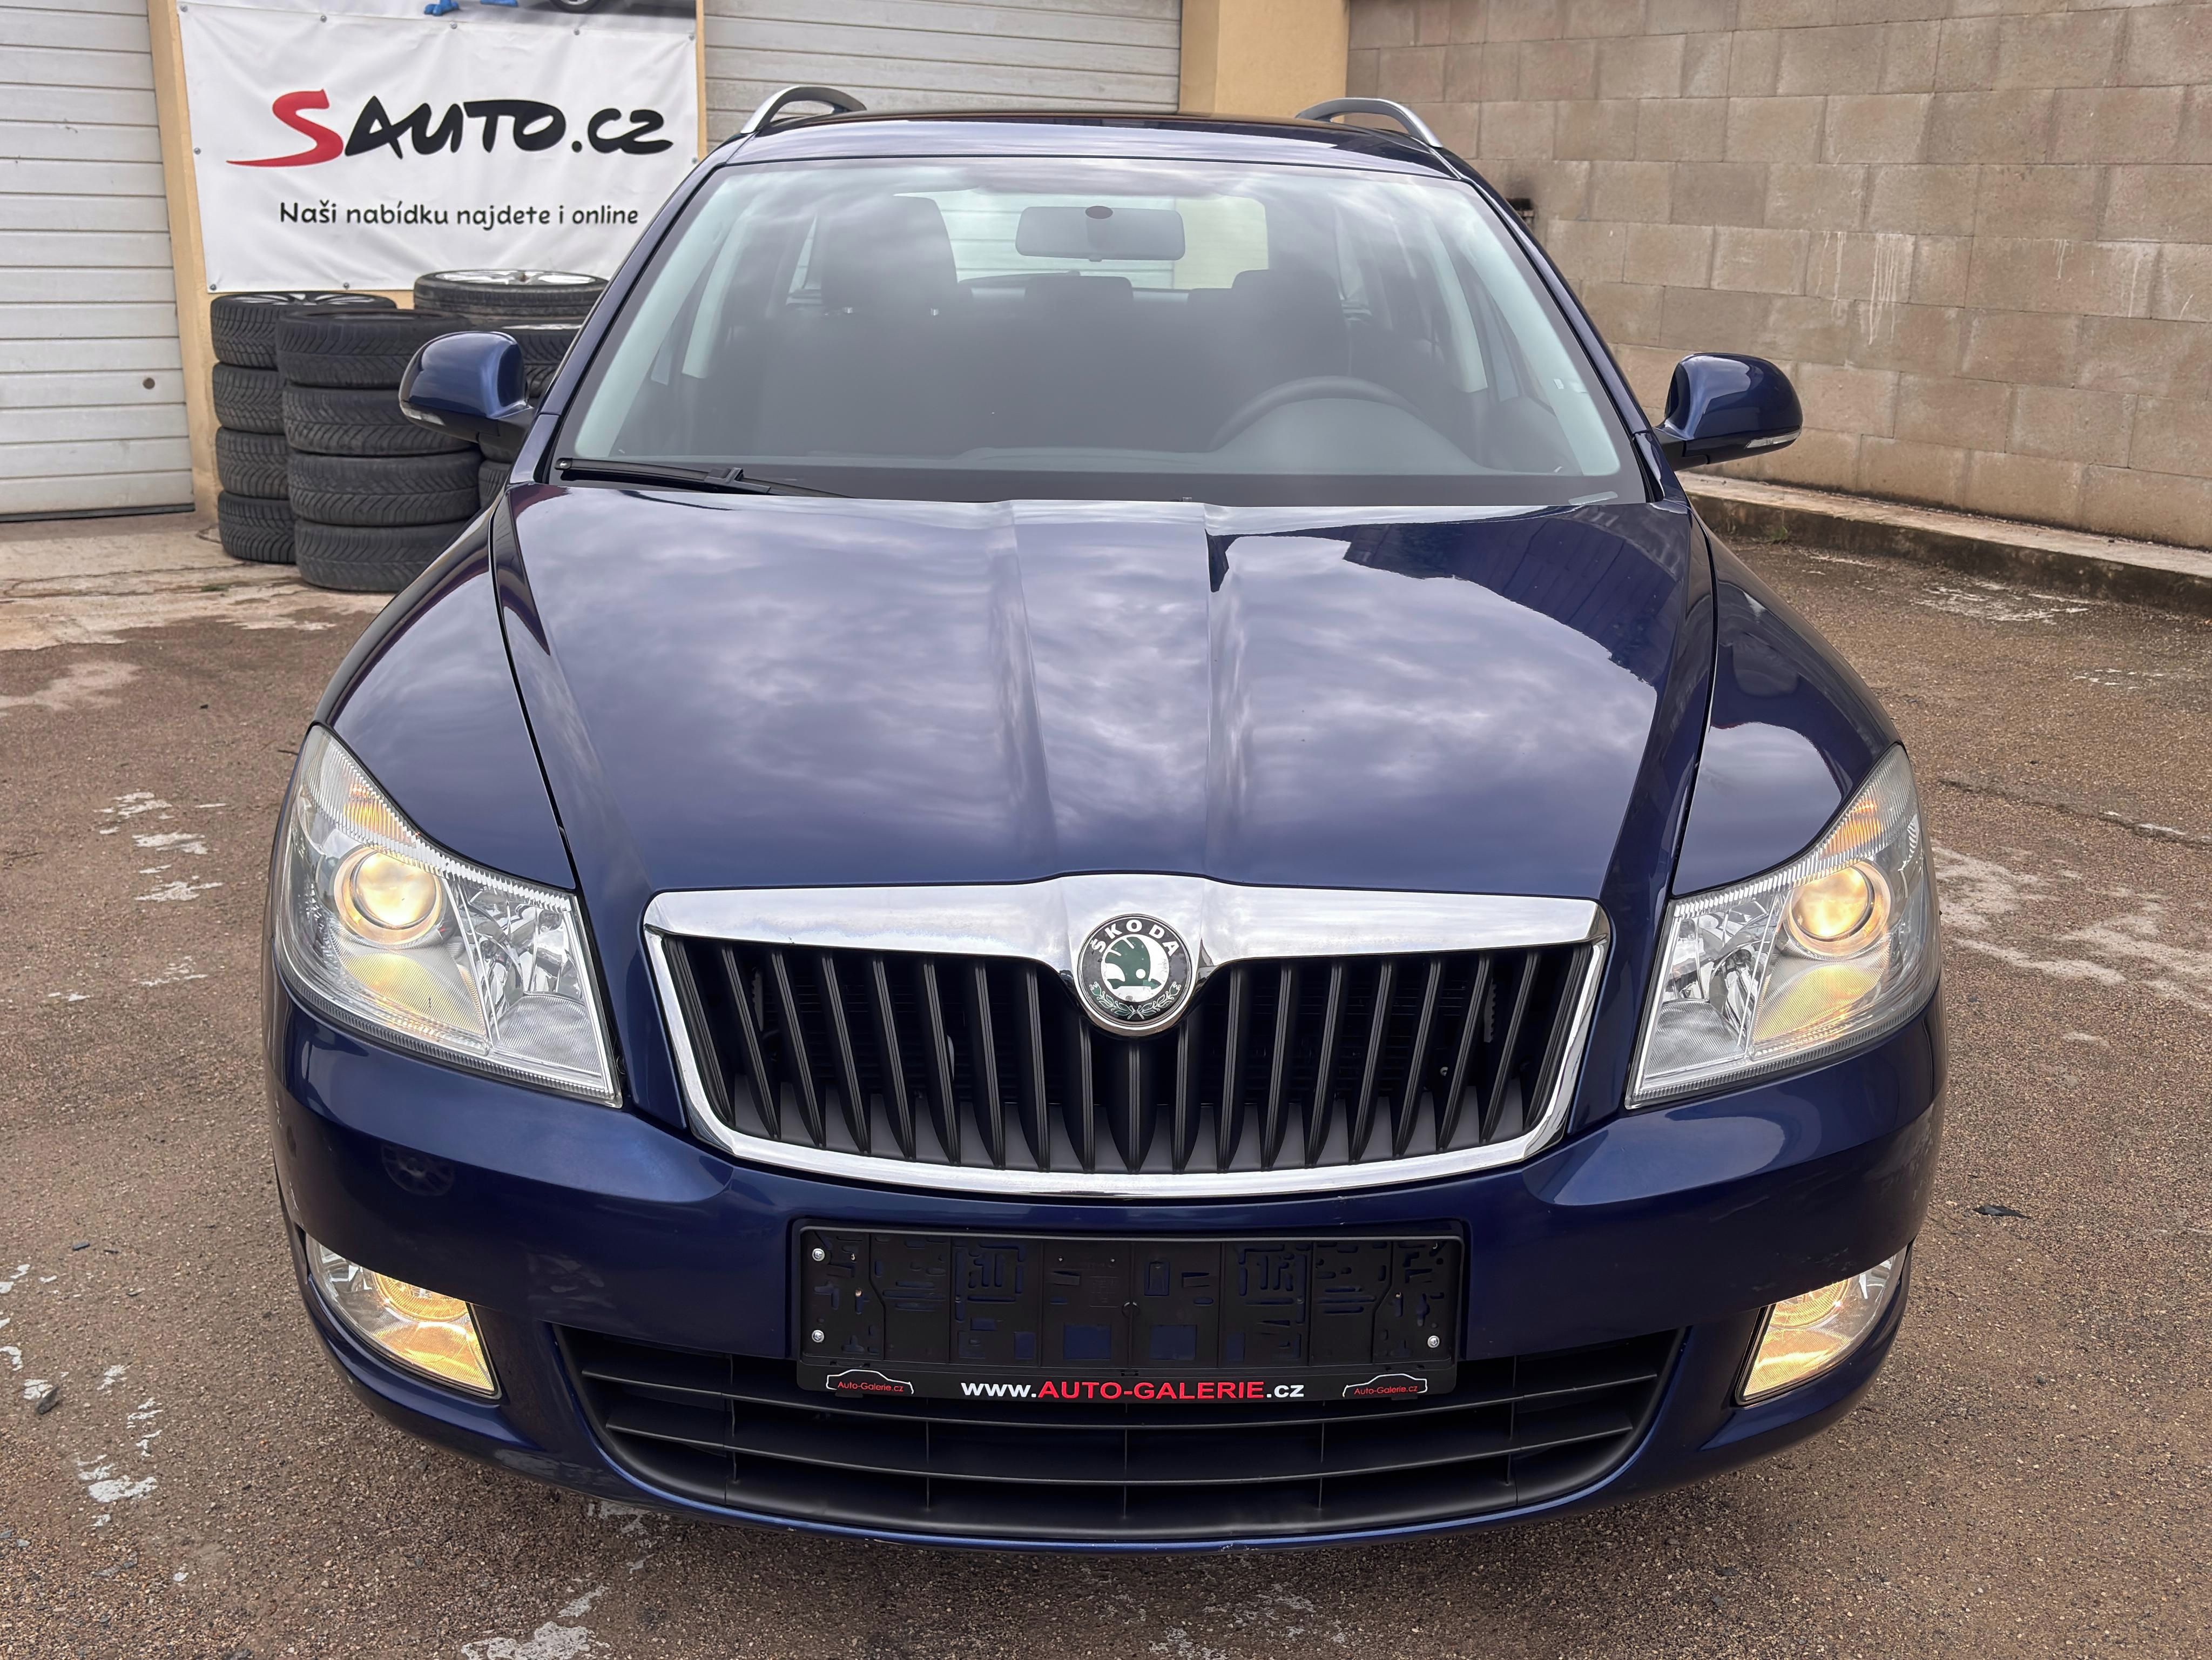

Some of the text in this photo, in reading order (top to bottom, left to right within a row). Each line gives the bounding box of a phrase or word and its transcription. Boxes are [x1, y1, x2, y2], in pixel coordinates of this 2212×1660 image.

[280, 200, 638, 231] Naši nabídku najdete i online
[838, 1381, 903, 1392] Auto-Galerie.cz
[961, 1381, 1304, 1400] www.AUTO-GALERIE.cz
[1354, 1386, 1418, 1395] Auto-Galerie.cz
